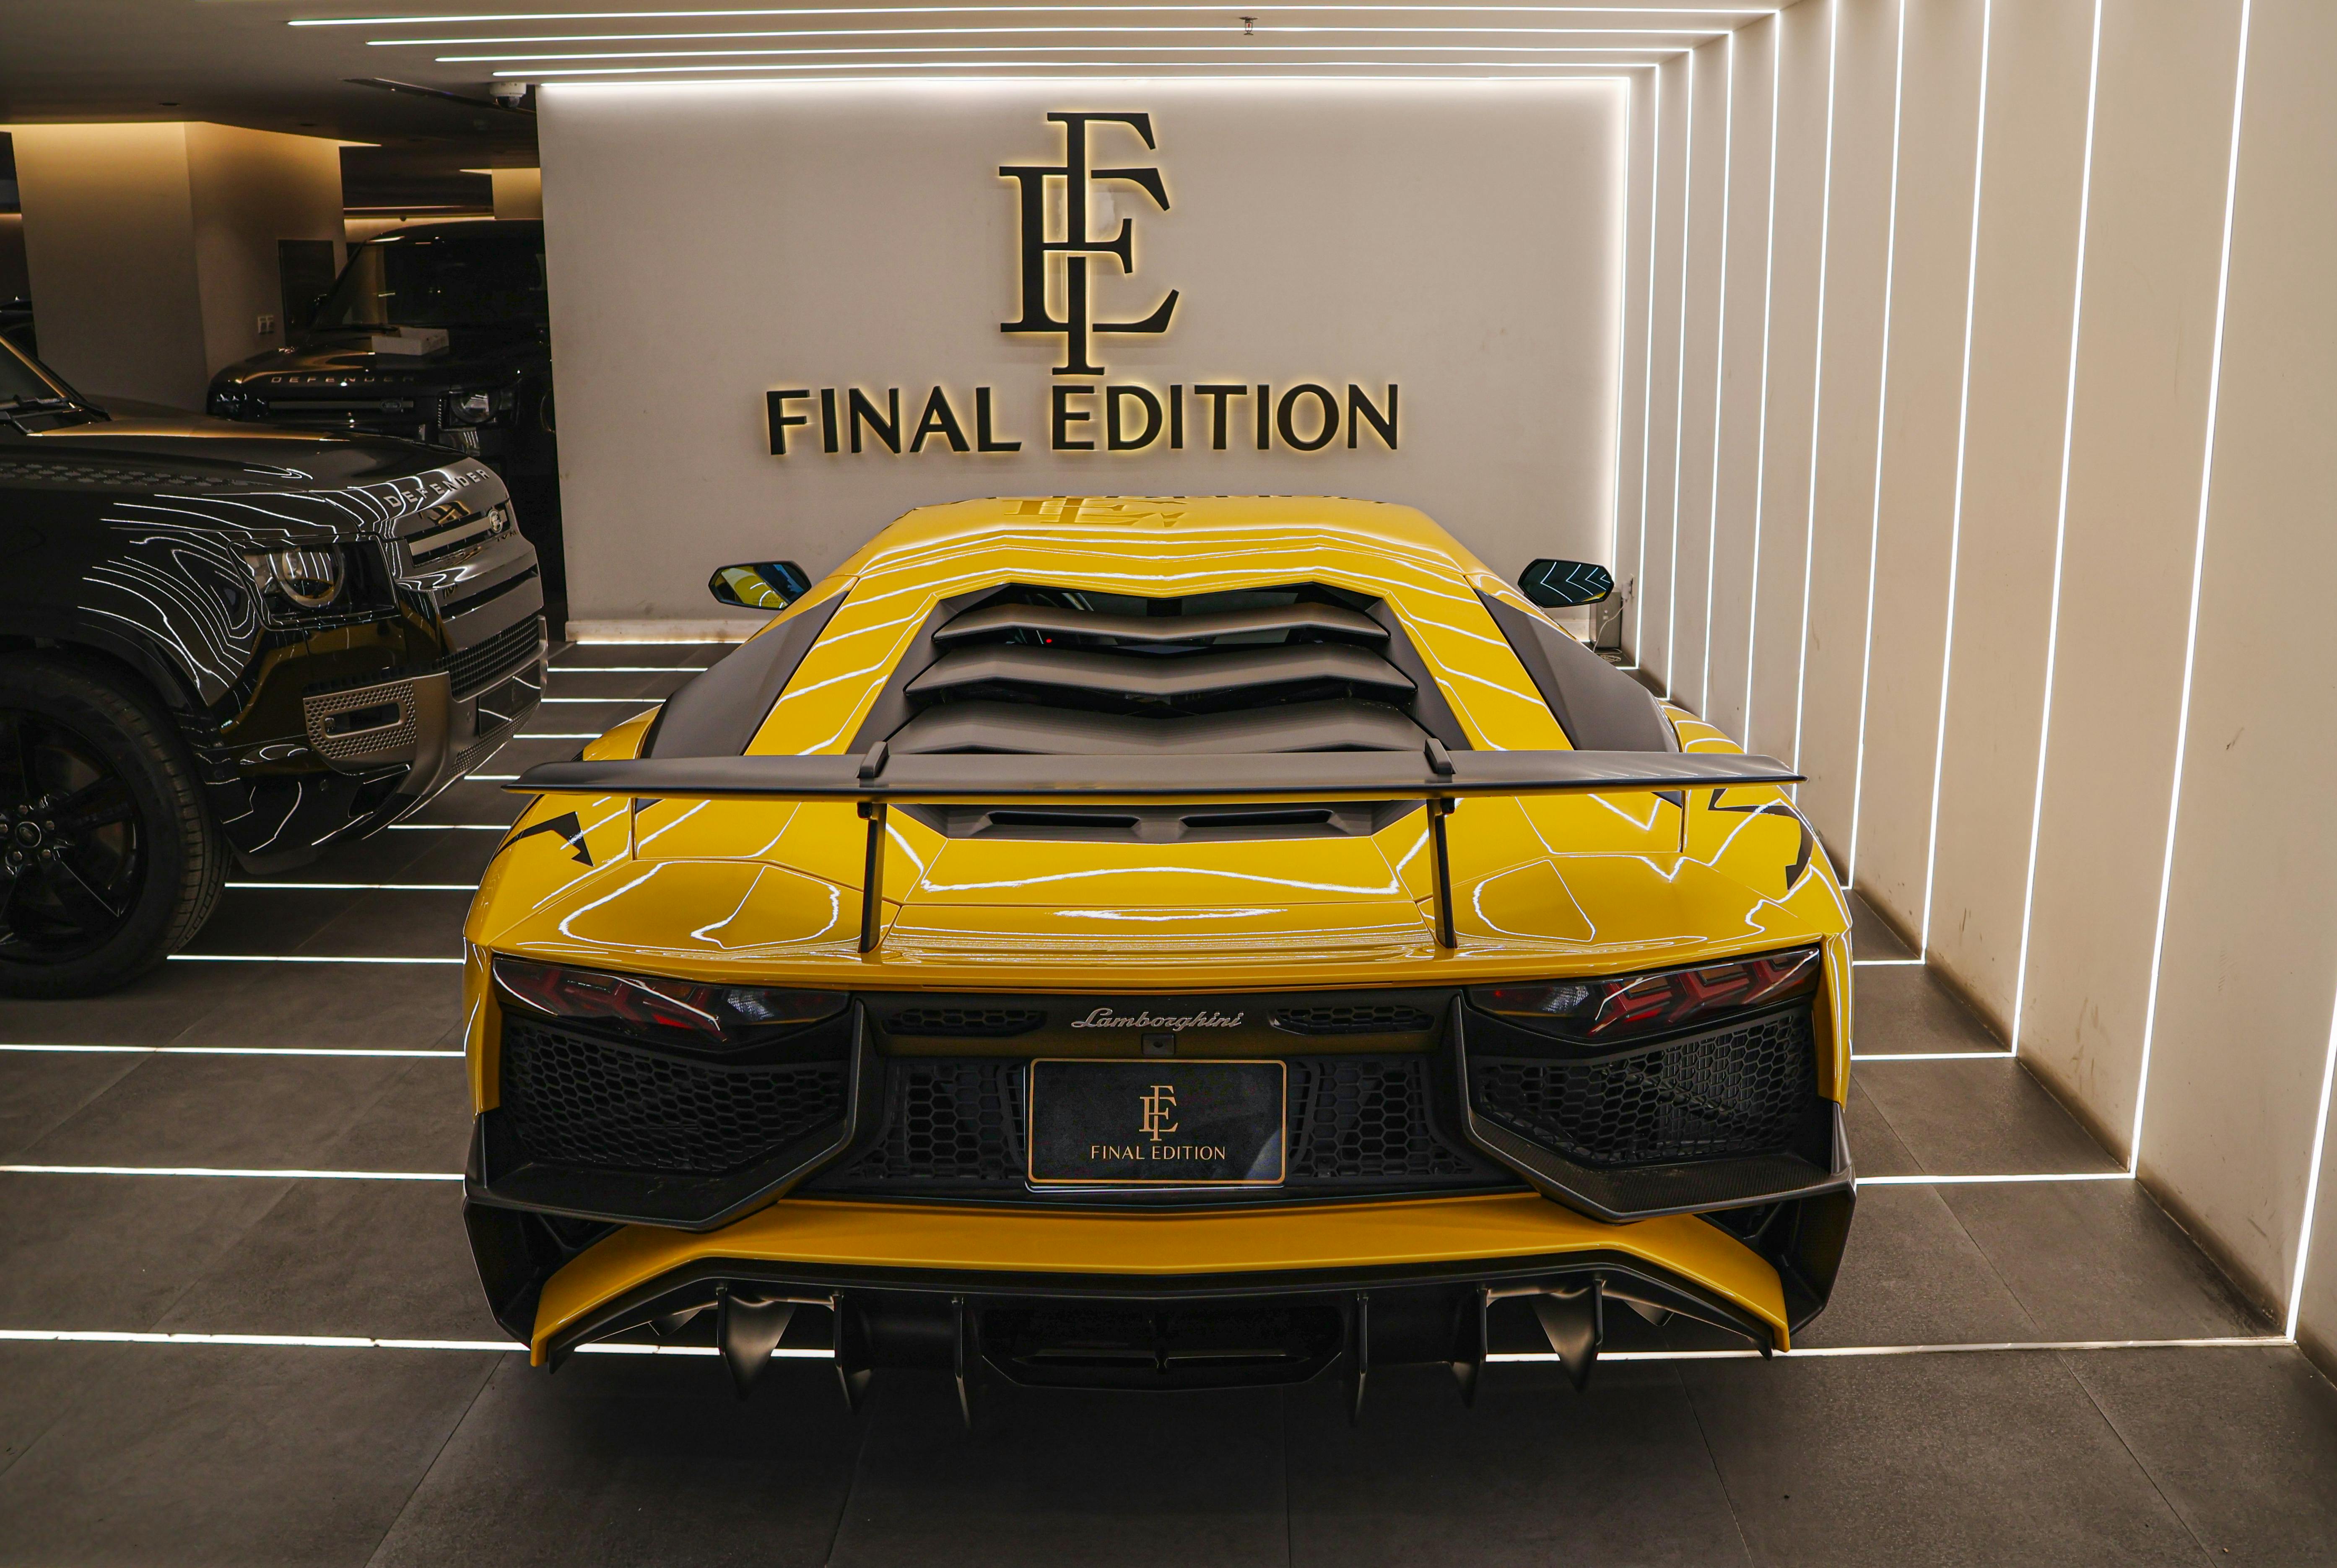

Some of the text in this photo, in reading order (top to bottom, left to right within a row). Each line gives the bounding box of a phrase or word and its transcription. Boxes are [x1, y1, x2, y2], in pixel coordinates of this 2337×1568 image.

[766, 384, 1398, 455] FINAL EDITION
[383, 469, 490, 508] DEFENDER
[1071, 1007, 1244, 1032] Lamborghini
[1091, 1145, 1225, 1160] FINAL EDITION
